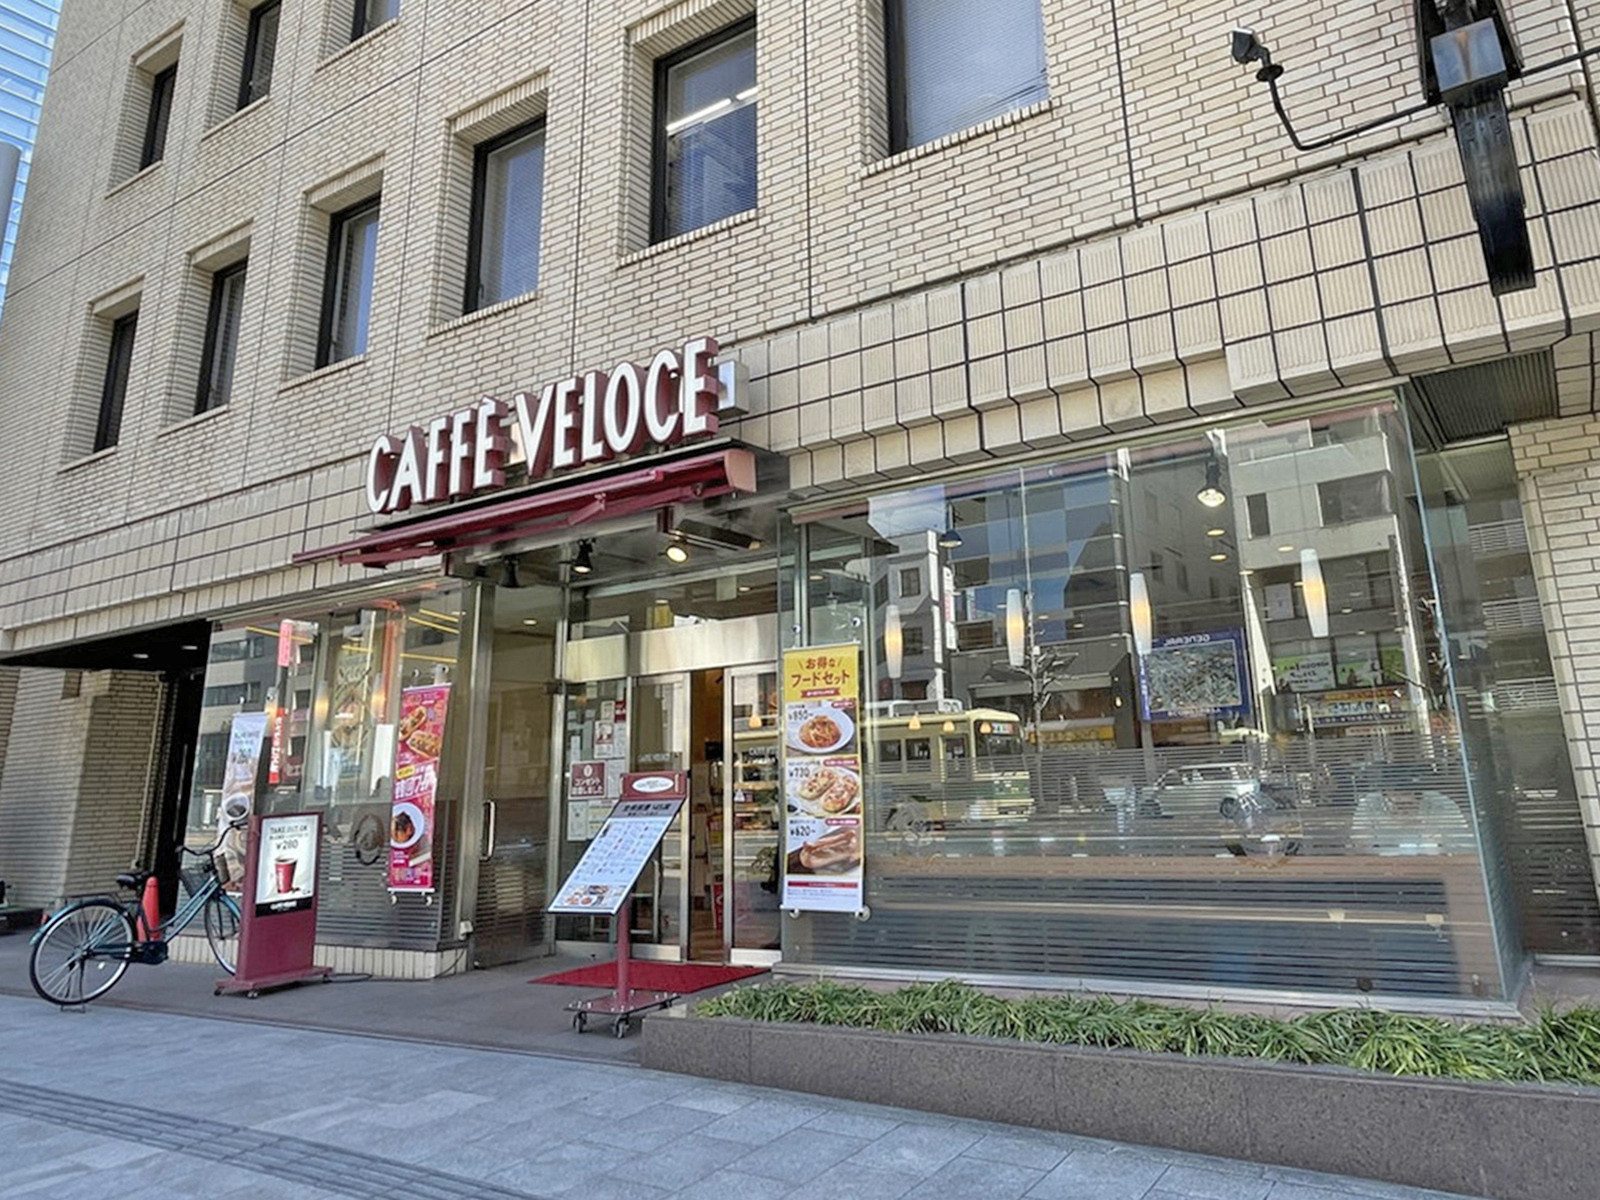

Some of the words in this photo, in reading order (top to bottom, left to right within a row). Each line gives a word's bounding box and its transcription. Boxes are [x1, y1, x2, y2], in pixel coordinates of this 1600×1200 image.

[515, 336, 720, 477] VELOCE
[805, 656, 836, 670] お得な
[791, 669, 850, 688] フードセット
